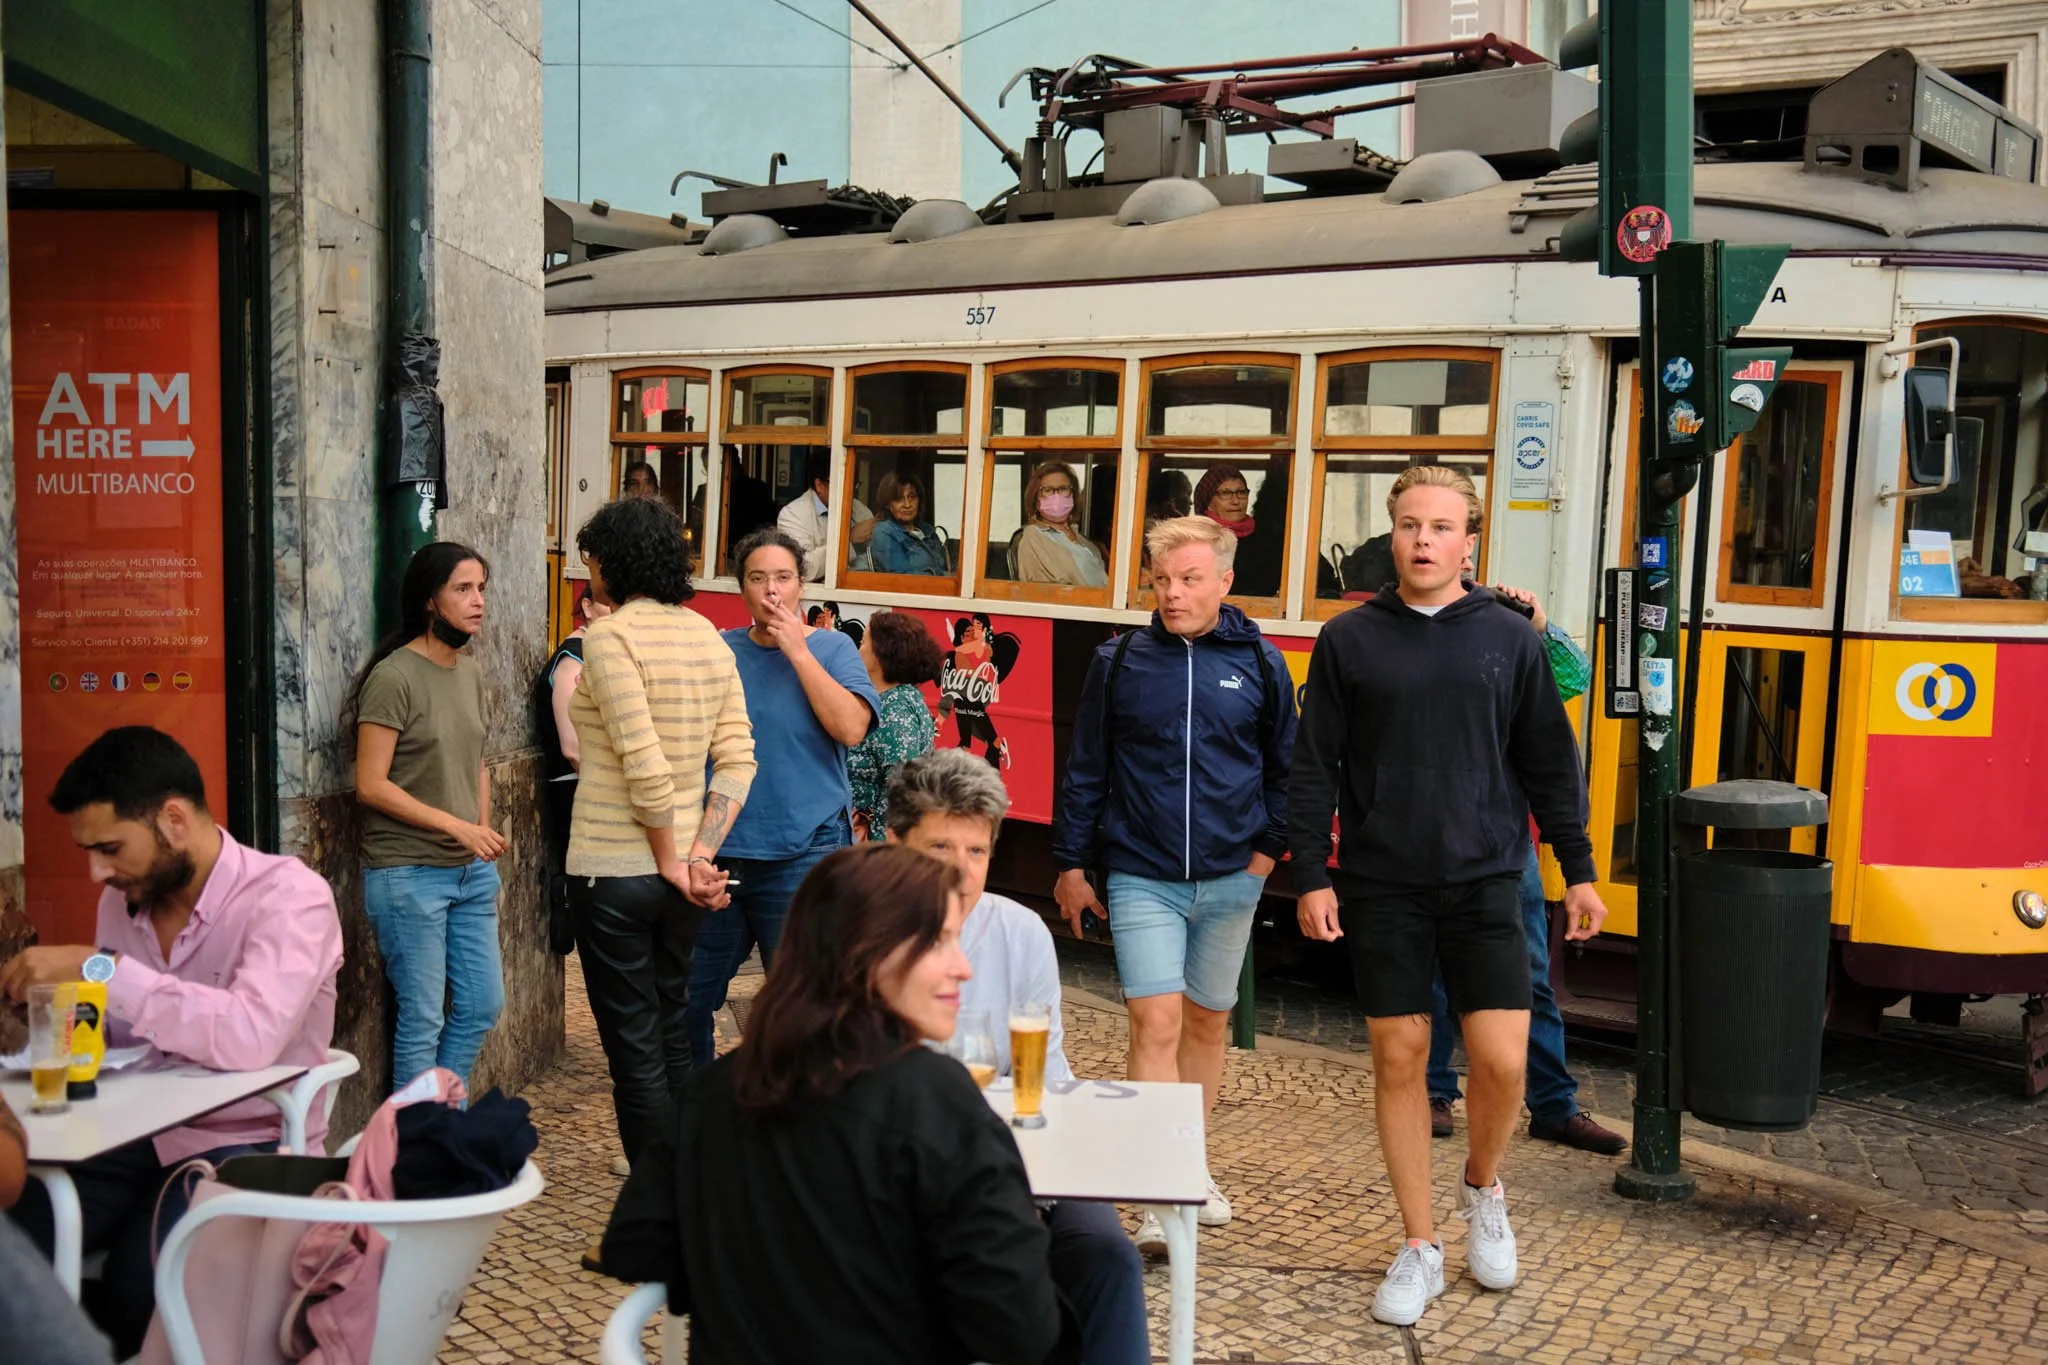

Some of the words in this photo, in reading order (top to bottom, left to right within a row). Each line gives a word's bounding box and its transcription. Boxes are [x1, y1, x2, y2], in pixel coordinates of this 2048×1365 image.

[1771, 287, 1787, 303] A
[966, 306, 996, 325] 557
[38, 372, 191, 425] ATM
[37, 428, 133, 459] HERE
[37, 472, 196, 494] MULTIBANCO
[1902, 576, 1924, 592] 02
